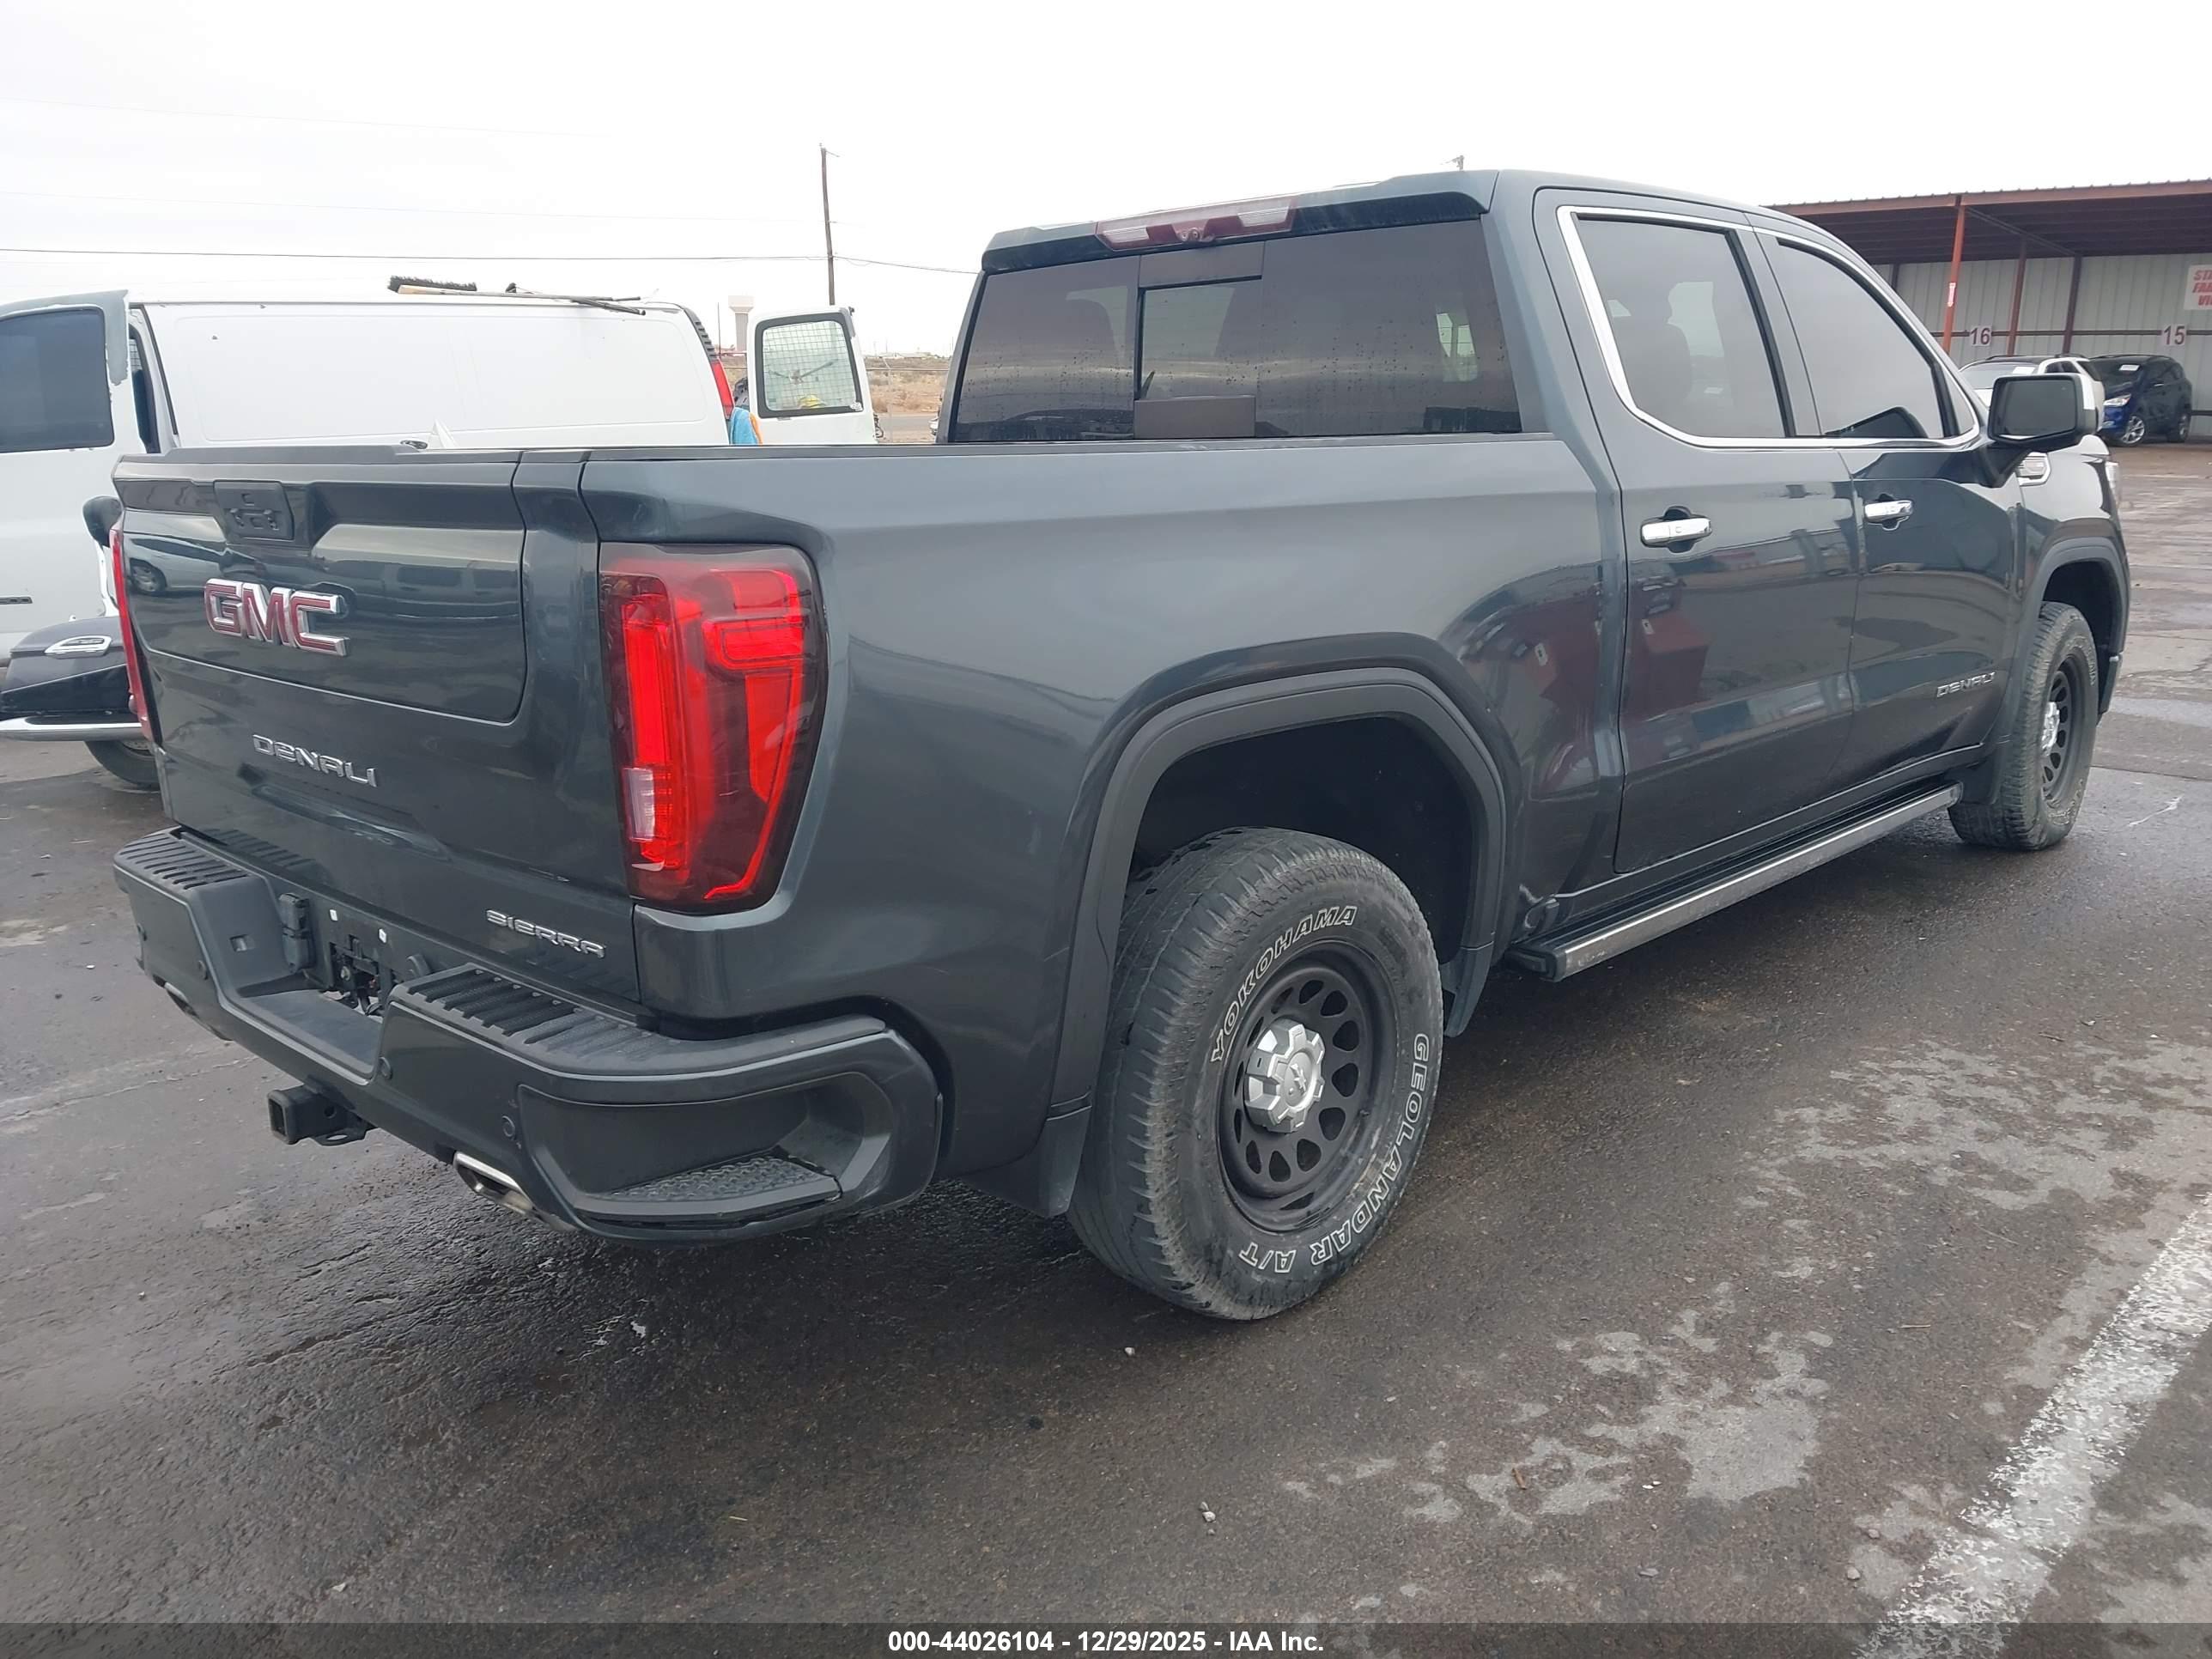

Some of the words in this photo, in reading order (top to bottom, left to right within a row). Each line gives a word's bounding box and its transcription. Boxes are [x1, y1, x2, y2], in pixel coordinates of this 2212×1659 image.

[1971, 327, 1990, 344] 16
[2164, 325, 2185, 345] 15
[204, 578, 349, 656] GMC
[1936, 672, 1996, 697] DENALI
[252, 734, 377, 787] DENALI
[486, 909, 605, 958] SIERRA
[1211, 905, 1358, 1062] YOKOHAMA
[1310, 1033, 1429, 1266] GEOLANDAR
[1239, 1243, 1297, 1273] A/T
